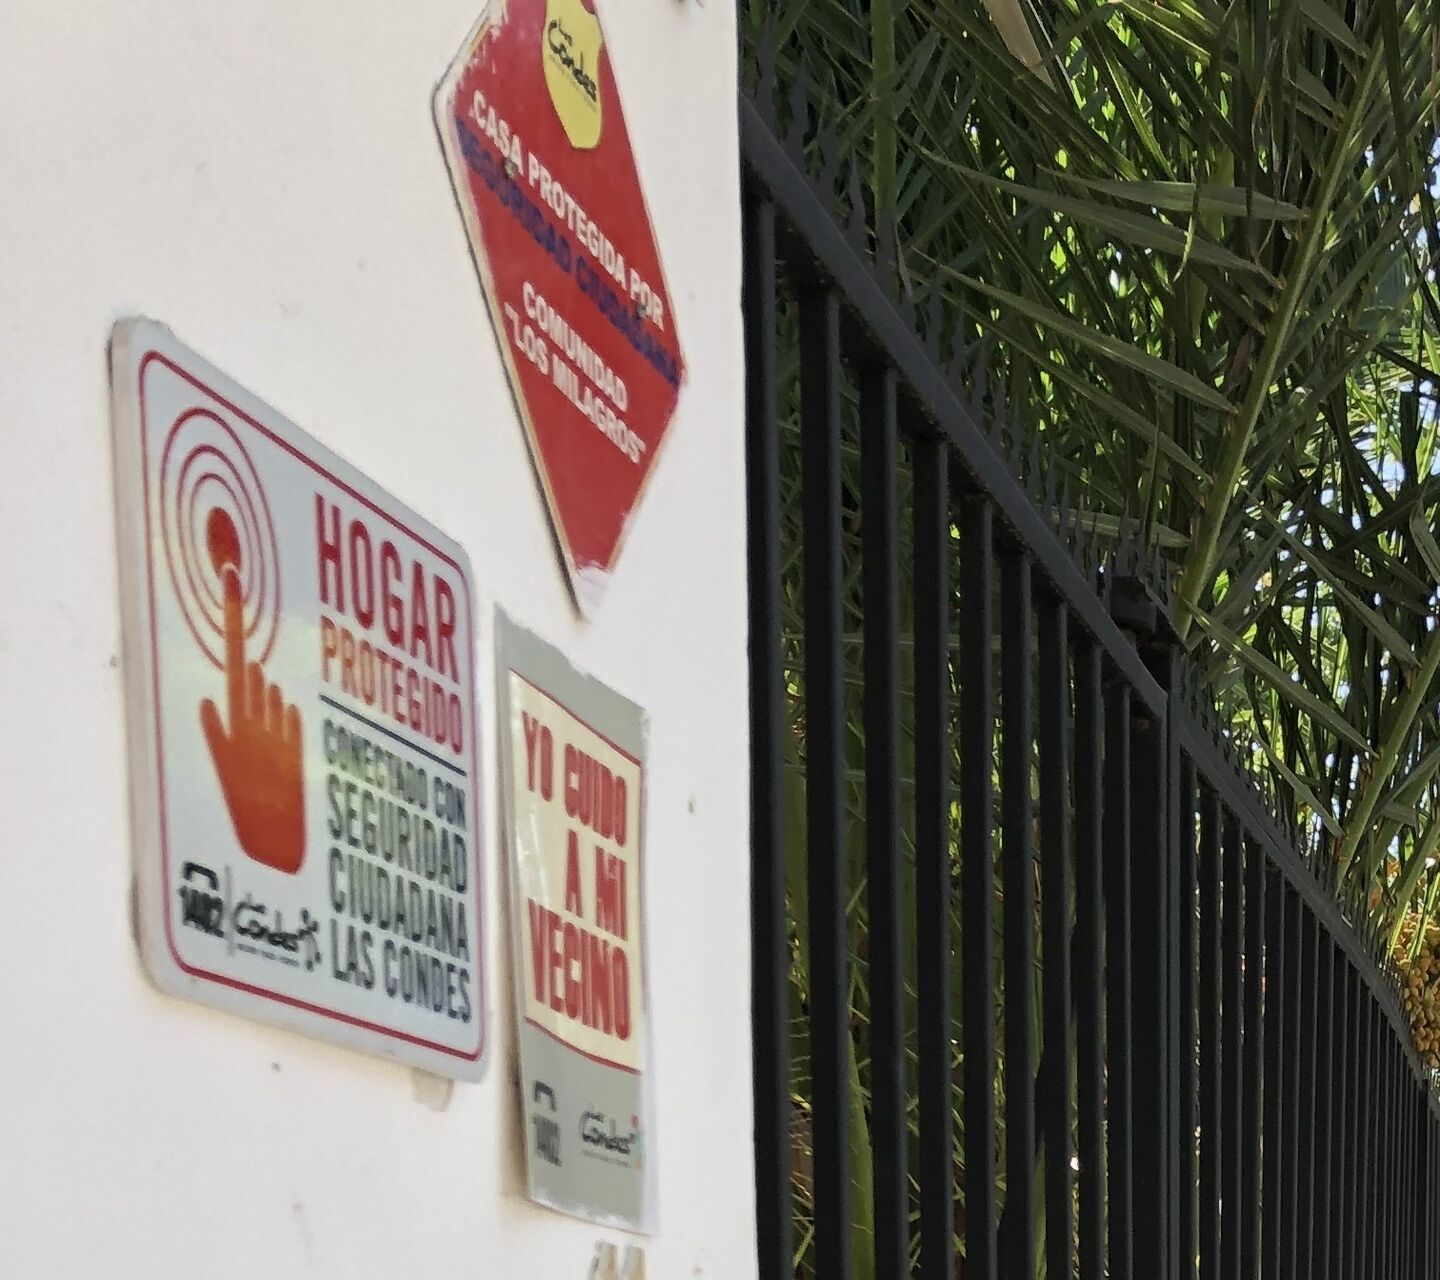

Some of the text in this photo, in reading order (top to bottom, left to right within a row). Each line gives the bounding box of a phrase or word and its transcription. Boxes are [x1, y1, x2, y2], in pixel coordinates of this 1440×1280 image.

[471, 89, 524, 177] CASA
[528, 151, 627, 291] PROTEGIDA
[630, 267, 665, 333] POR
[522, 281, 628, 413] COMUNIDAD
[315, 491, 461, 686] HOGAR
[320, 614, 463, 755] PROTEGIDO
[324, 718, 467, 832] CONECTADO CON
[328, 773, 468, 894] SEGURIDAD
[522, 709, 628, 848] YO CUIDO
[329, 847, 470, 1013] CIUDADANA
[564, 828, 628, 942] A MI
[330, 918, 472, 1023] LAS CONDES
[527, 897, 631, 1041] VECINO
